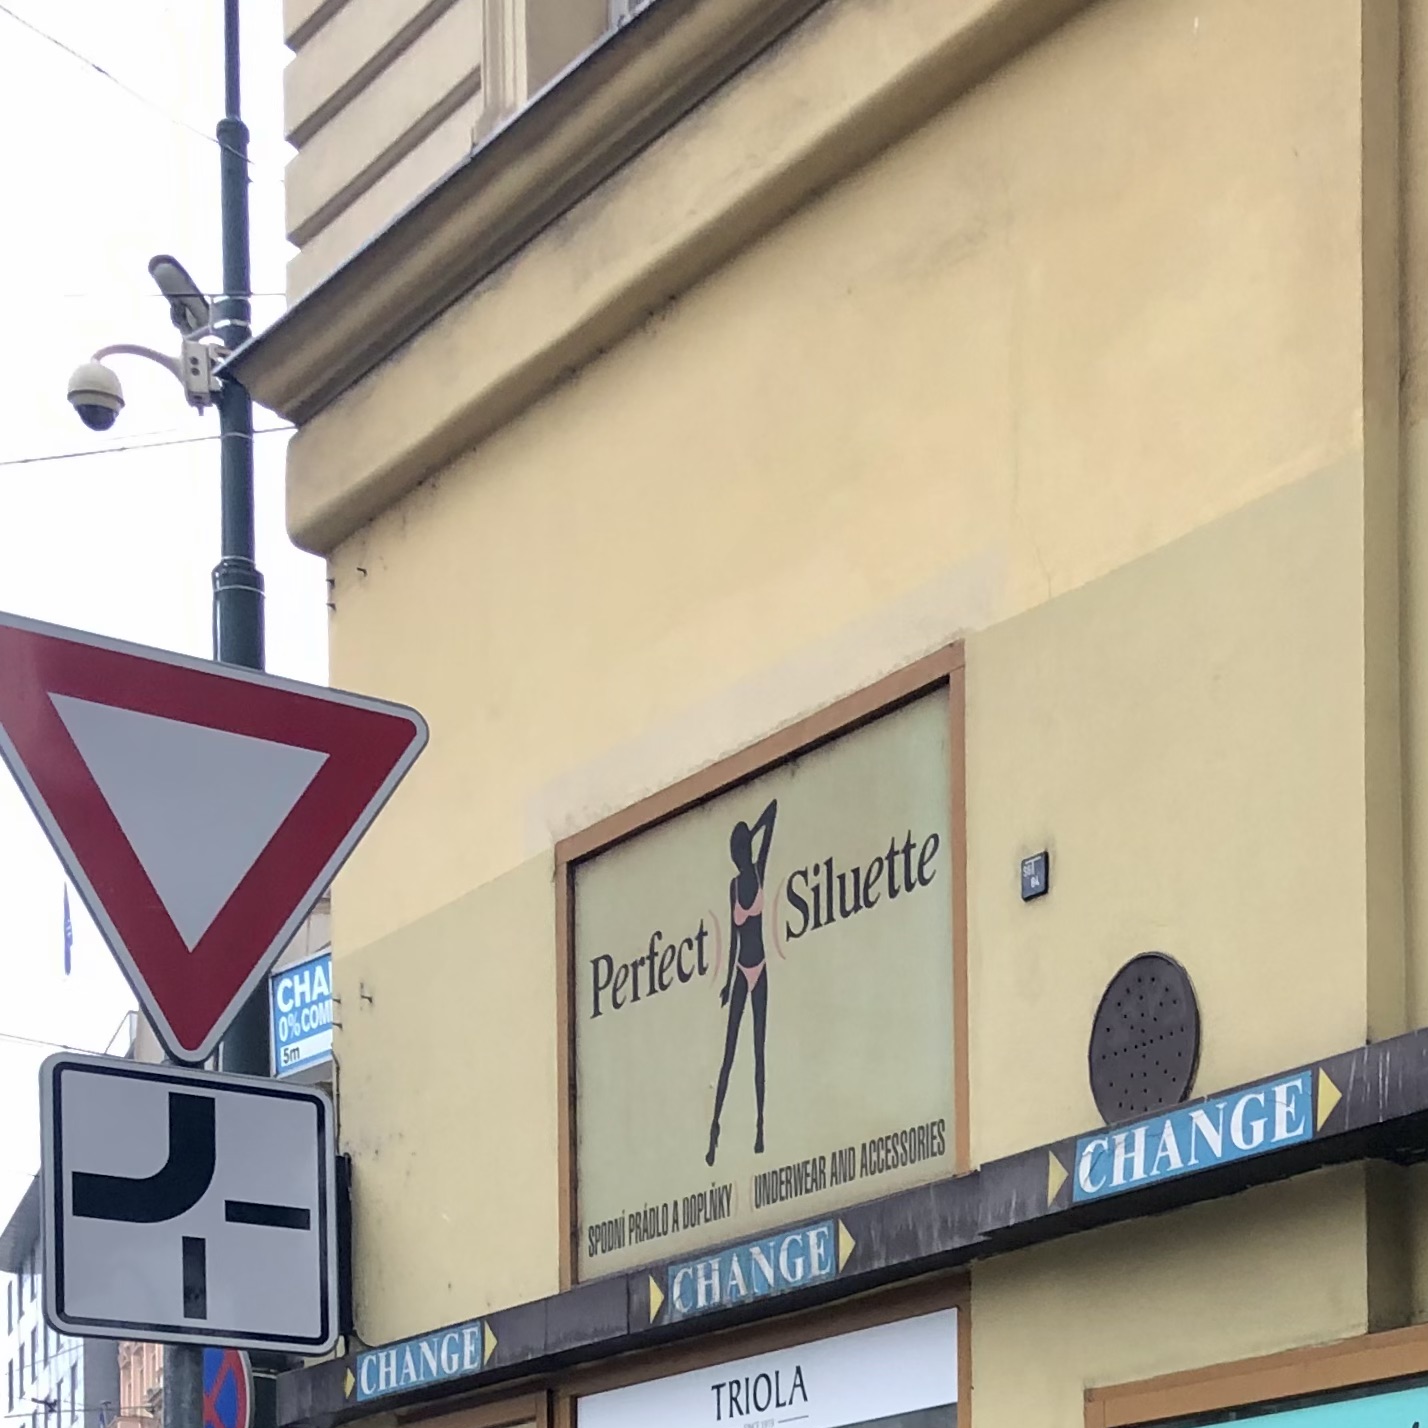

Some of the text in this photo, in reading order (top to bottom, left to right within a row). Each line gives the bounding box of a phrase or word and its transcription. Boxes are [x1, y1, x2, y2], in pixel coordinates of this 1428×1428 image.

[589, 829, 940, 1019] Perfect Siluette
[277, 961, 332, 1013] CHA
[279, 999, 333, 1042] 0% COM
[754, 1118, 946, 1209] UNDERWEAR AND ACCESSORIES
[1078, 1079, 1305, 1194] CHANGE
[588, 1182, 734, 1258] SPODNÍ PRÁDLO A DOPLŇKY
[672, 1226, 833, 1313] CHANGE
[360, 1327, 479, 1395] CHANGE
[711, 1365, 808, 1421] TRIOLA
